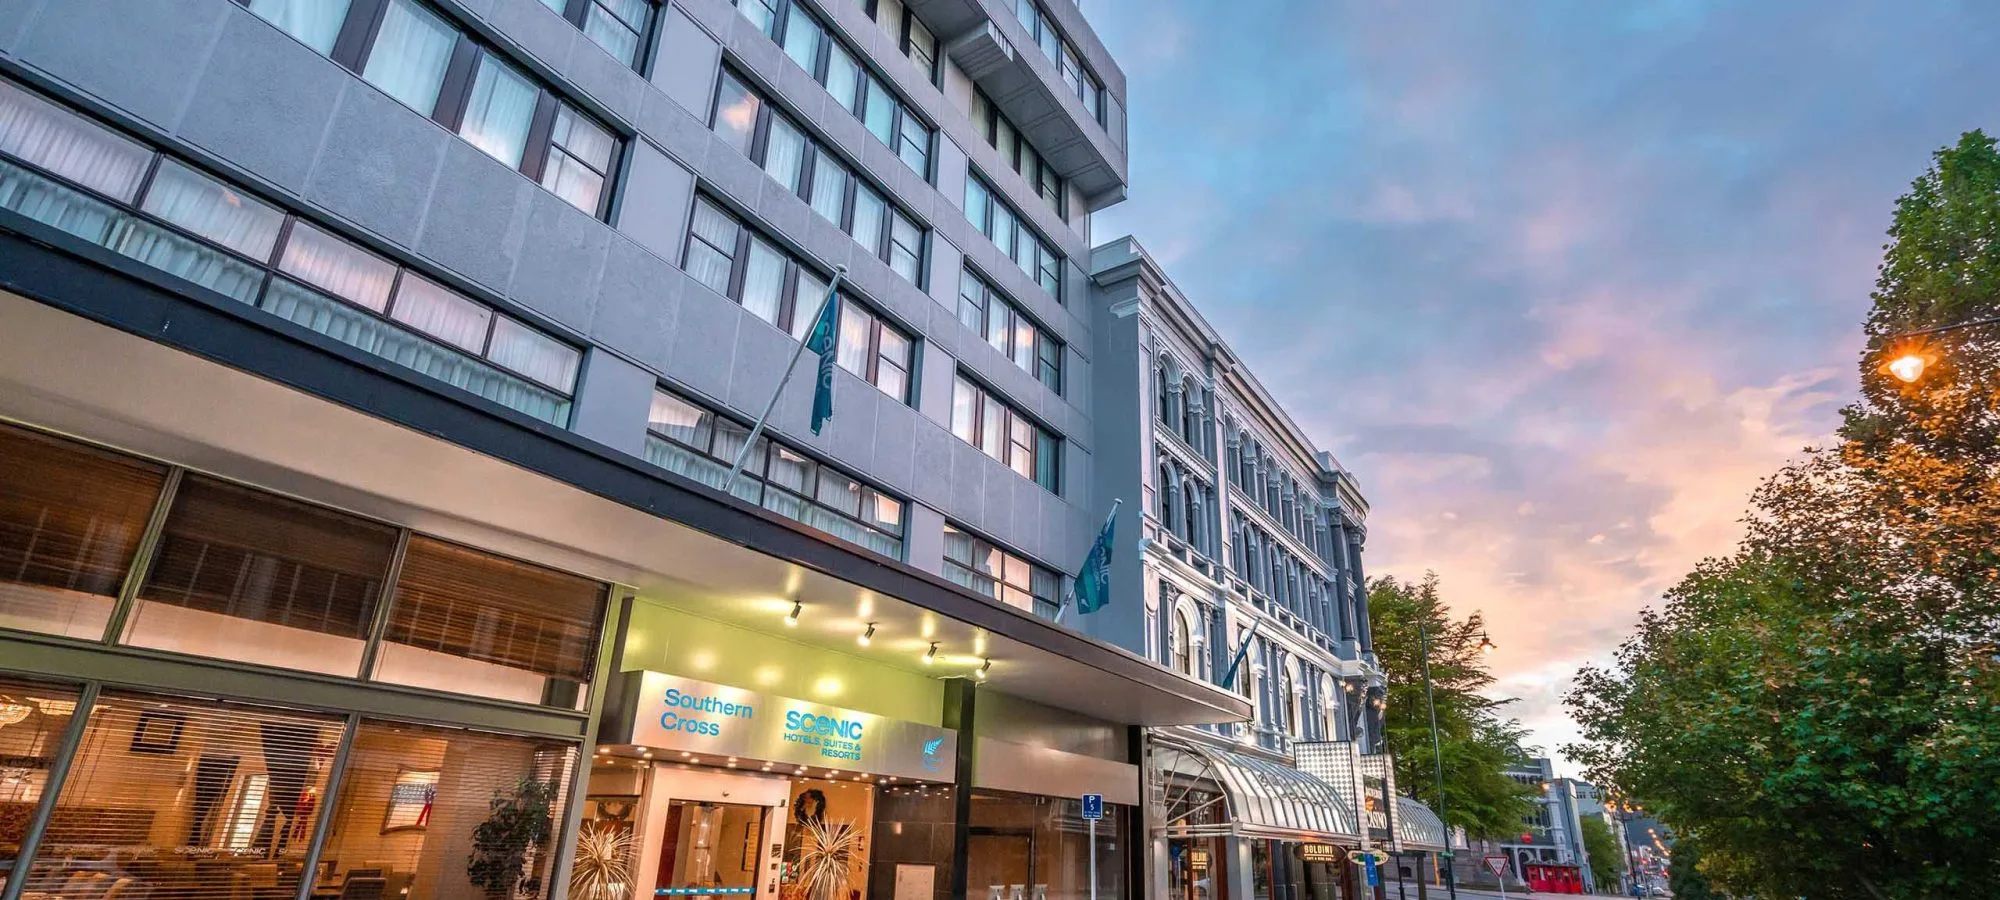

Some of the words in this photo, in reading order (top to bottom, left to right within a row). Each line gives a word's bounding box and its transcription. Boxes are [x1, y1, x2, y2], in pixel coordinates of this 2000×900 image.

[664, 688, 753, 719] Southern
[660, 711, 720, 736] Cross
[824, 738, 853, 750] SUITES
[821, 748, 860, 760] RESORTS
[1304, 845, 1333, 854] BOLDINI
